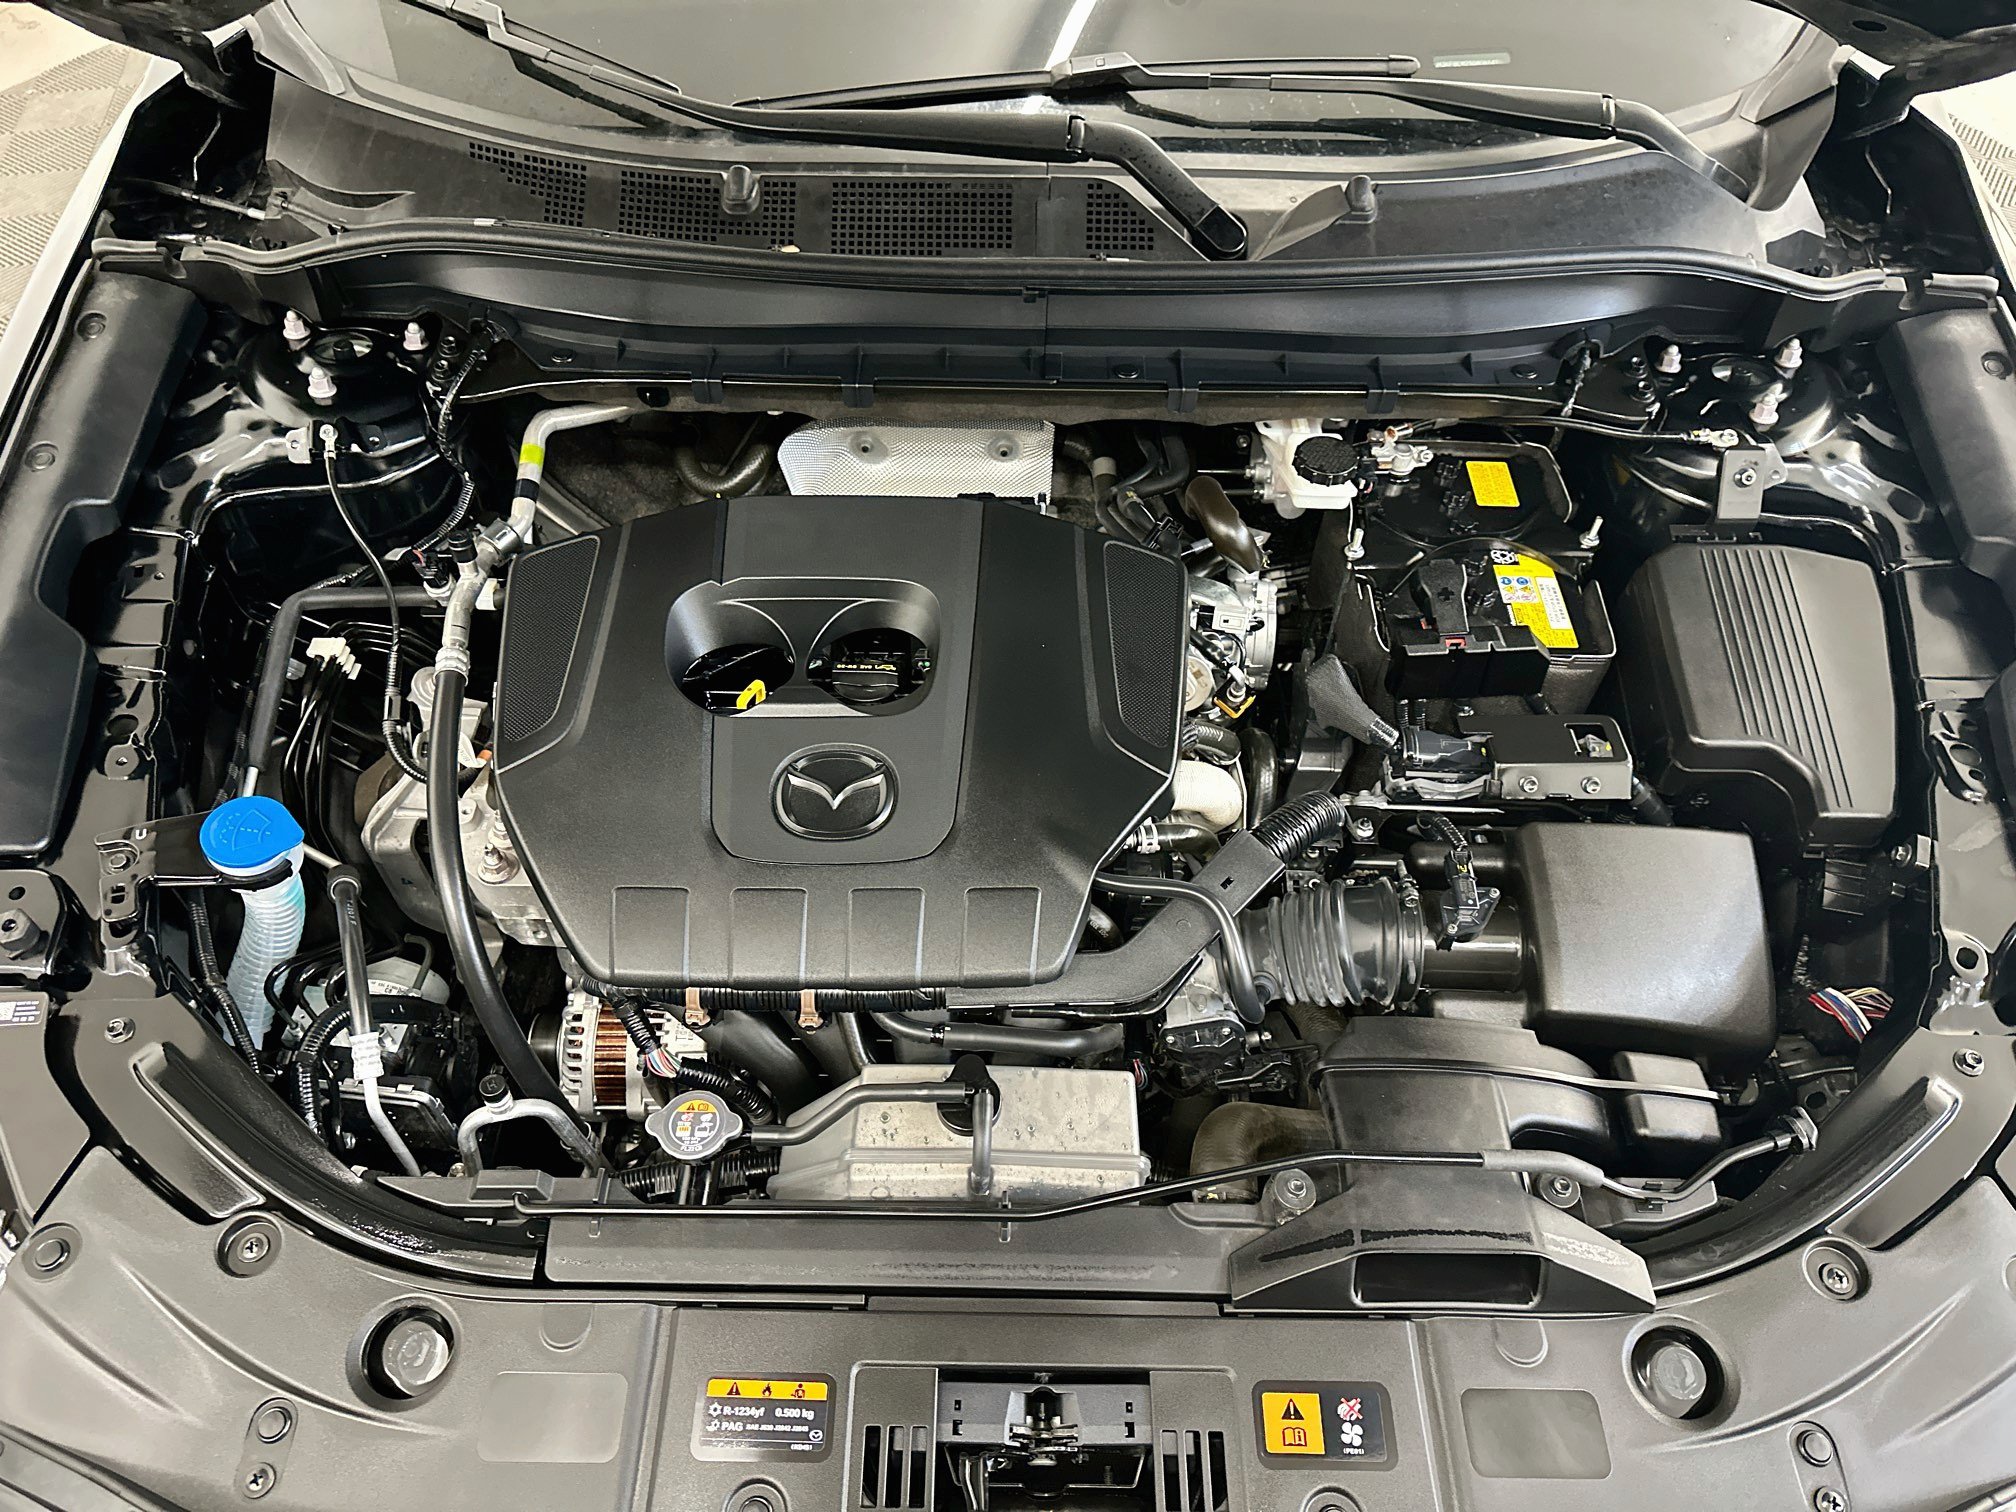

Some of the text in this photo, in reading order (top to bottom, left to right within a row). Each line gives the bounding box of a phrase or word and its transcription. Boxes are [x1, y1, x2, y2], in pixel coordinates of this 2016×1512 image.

[722, 1406, 815, 1420] R-1234yf 0.500 kg
[721, 1421, 743, 1432] PAG
